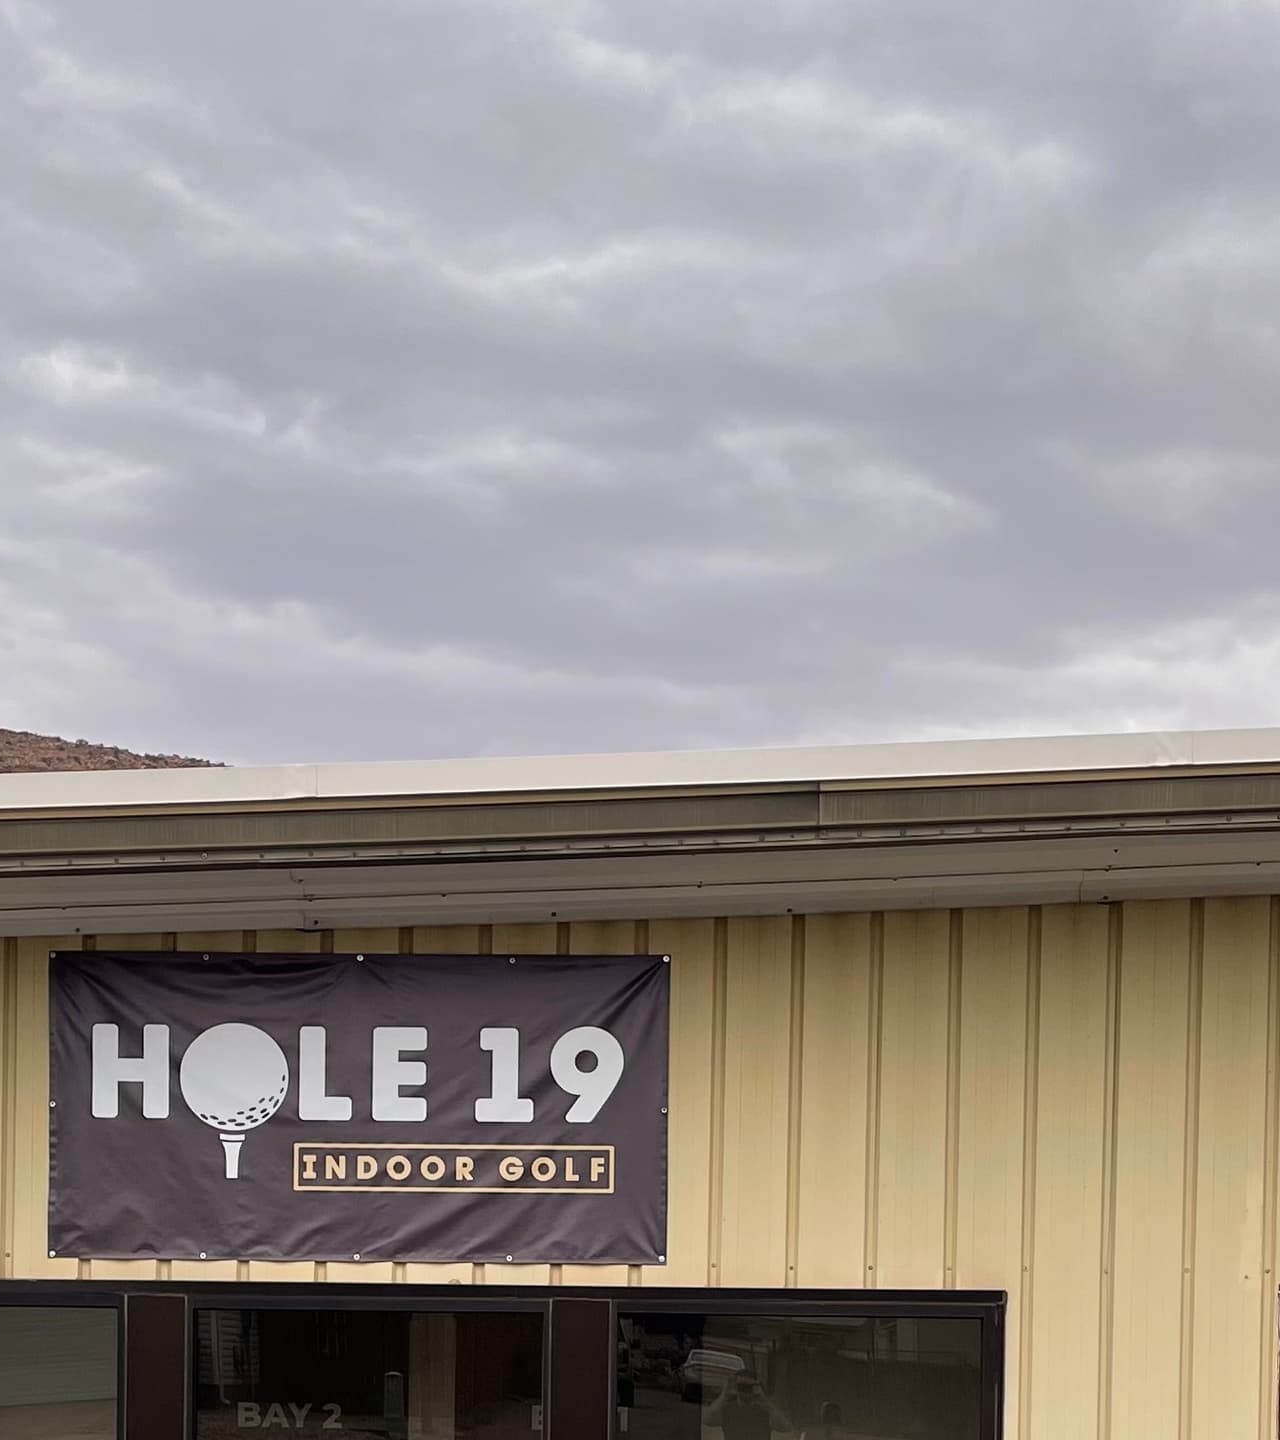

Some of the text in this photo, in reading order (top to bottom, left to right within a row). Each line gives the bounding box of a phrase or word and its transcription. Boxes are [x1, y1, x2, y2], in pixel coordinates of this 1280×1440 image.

[91, 1022, 625, 1131] HOLE 19
[301, 1154, 606, 1182] INDOOR GOLF
[237, 1401, 343, 1430] BAY 2
